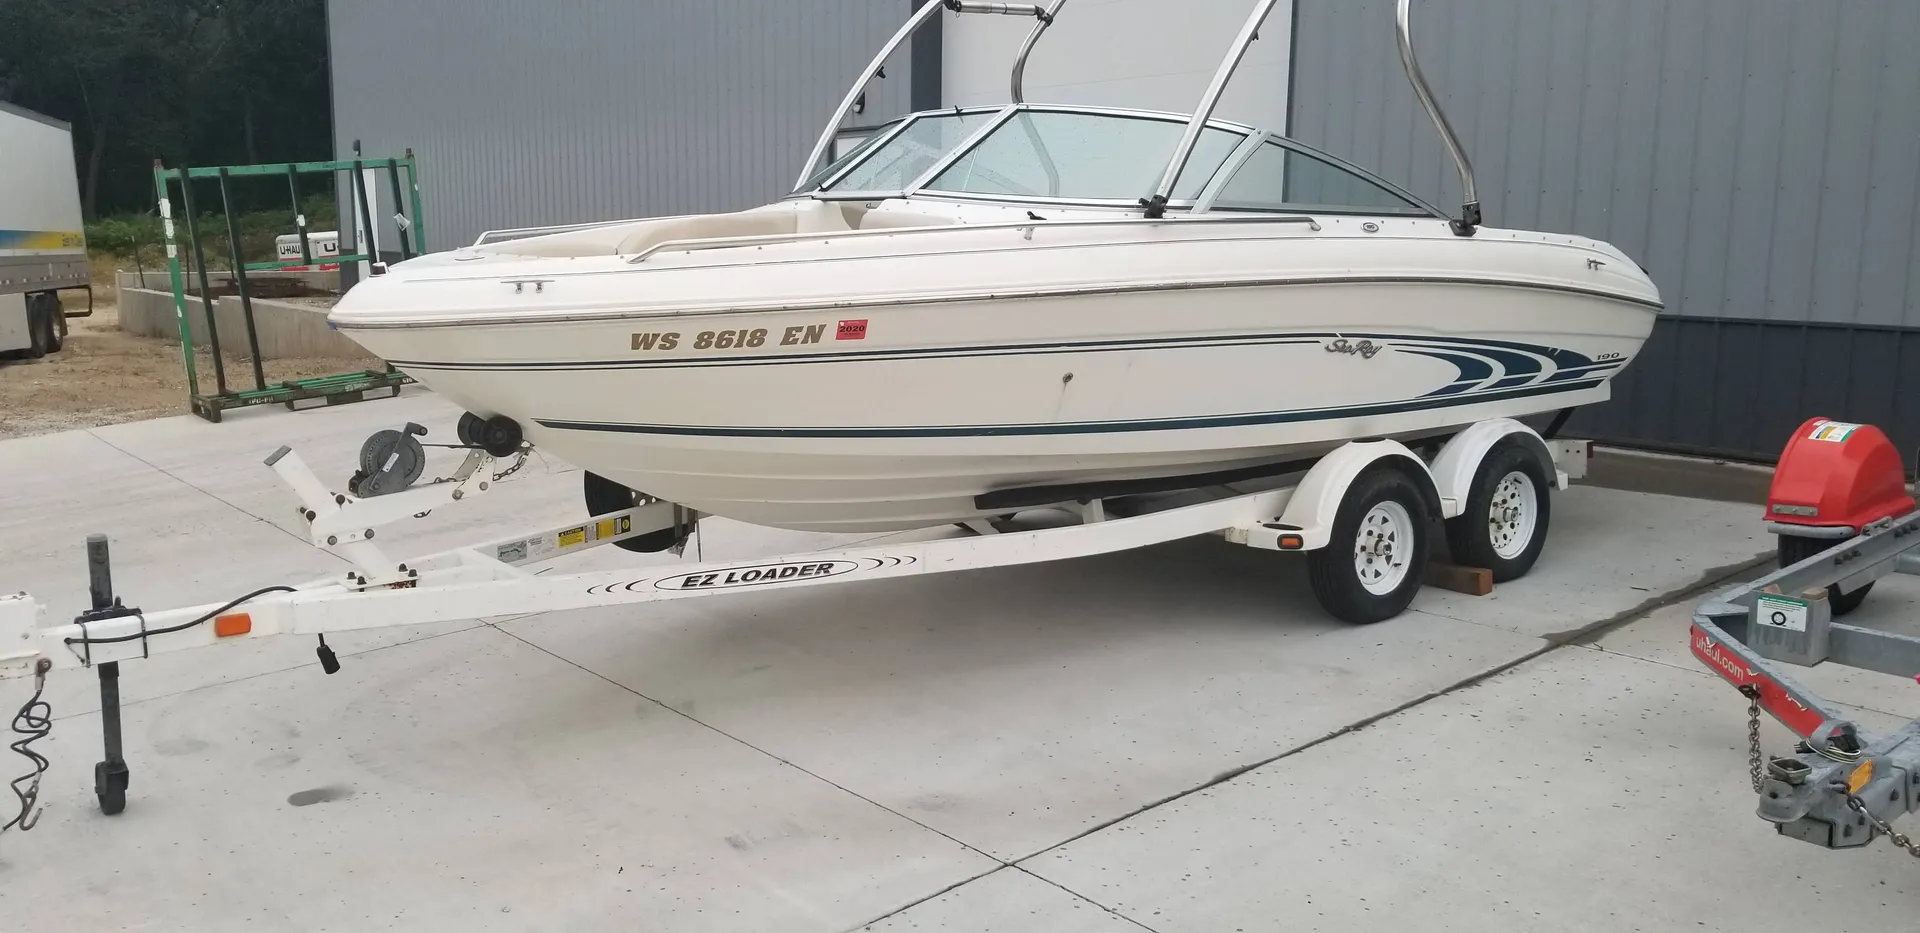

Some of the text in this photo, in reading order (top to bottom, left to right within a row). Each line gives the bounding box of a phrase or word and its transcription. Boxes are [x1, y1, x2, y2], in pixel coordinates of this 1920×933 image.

[280, 245, 302, 255] U-HAU
[631, 324, 827, 350] WS 8618 EN
[1597, 352, 1620, 360] 190
[681, 562, 835, 588] EZ LOADER
[1696, 637, 1744, 681] uhaul.com
